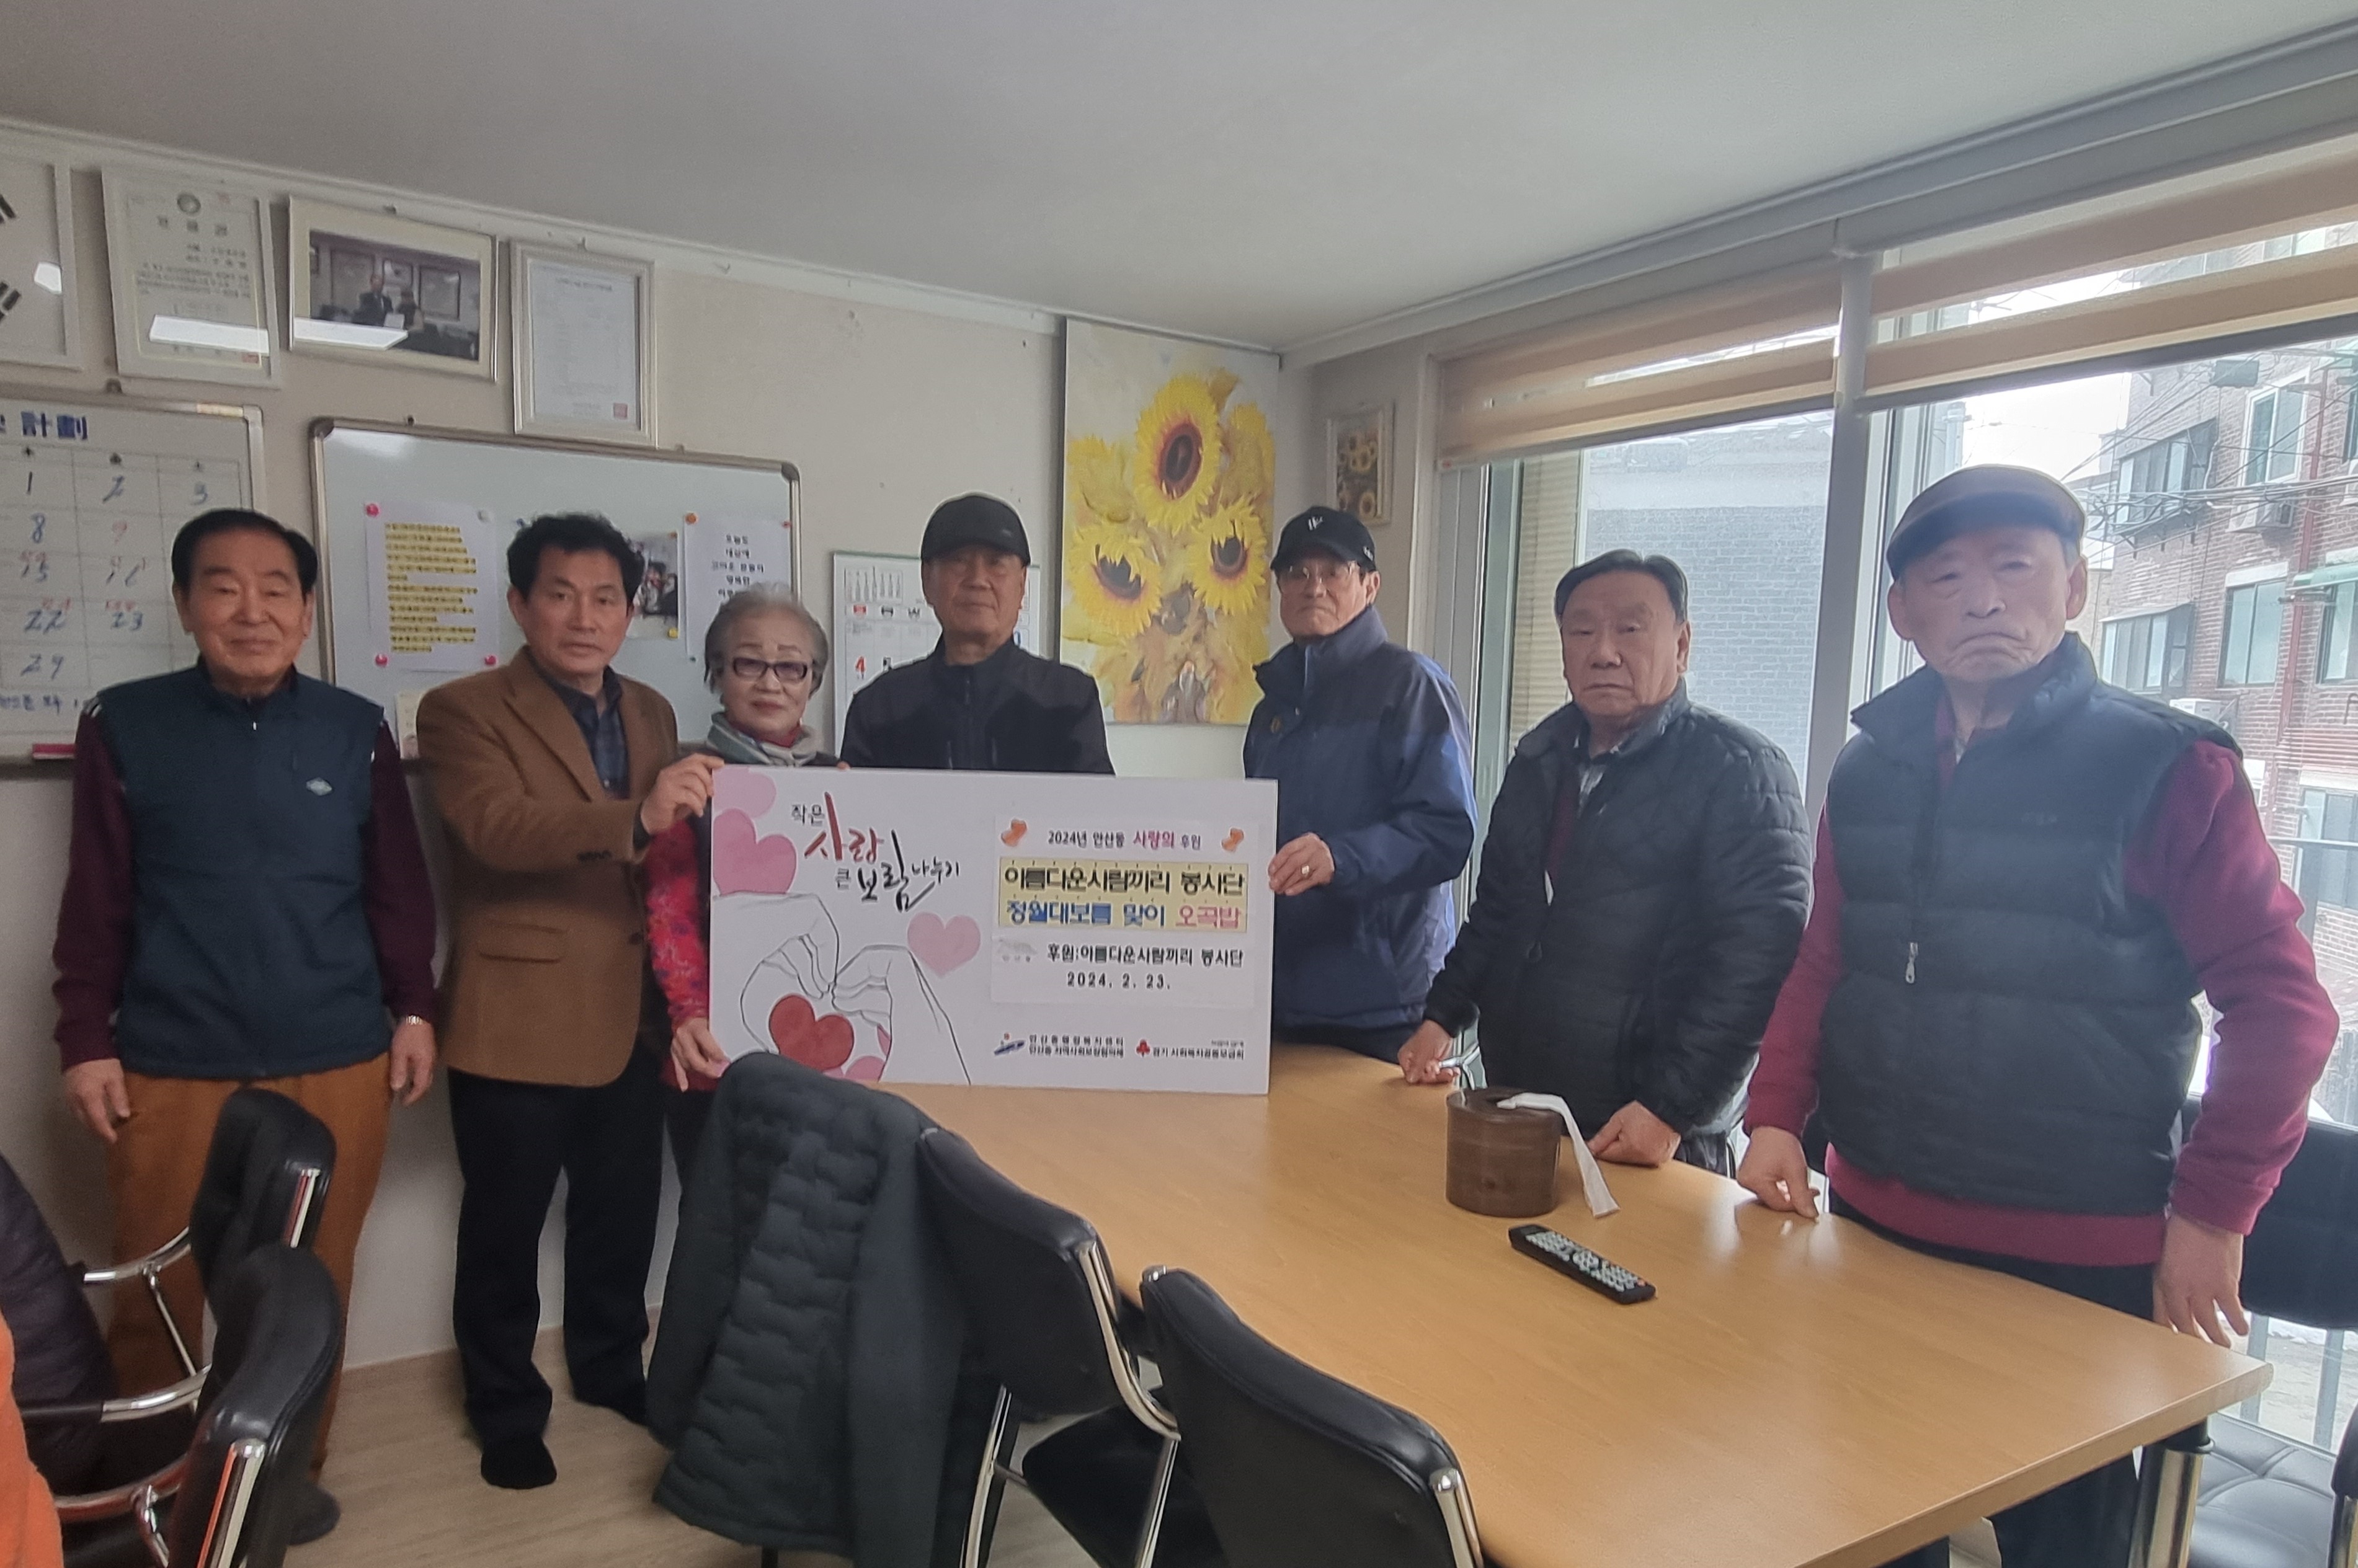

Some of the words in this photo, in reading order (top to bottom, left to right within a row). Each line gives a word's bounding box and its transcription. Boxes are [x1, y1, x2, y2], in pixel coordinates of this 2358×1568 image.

[32, 513, 45, 544] 8
[25, 609, 65, 634] 22
[111, 612, 143, 631] 23
[791, 805, 824, 826] 작은
[804, 792, 884, 862] 사랑
[1048, 831, 1087, 848] 2024년
[1132, 830, 1175, 850] 사랑의
[1181, 834, 1201, 850] 후원
[836, 868, 850, 890] 큰
[858, 830, 935, 913] 보람
[912, 856, 959, 885] 나누기
[1005, 867, 1170, 894] 아름다운사람끼리
[1181, 870, 1245, 897] 봉사단
[1007, 900, 1112, 926] 정월대보름
[1123, 903, 1165, 927] 맞이
[1175, 905, 1240, 928] 오곡밥
[1201, 948, 1243, 967] 봉사단
[1067, 971, 1113, 989] 2024.
[1122, 972, 1137, 989] 2.
[1146, 973, 1170, 990] 23.
